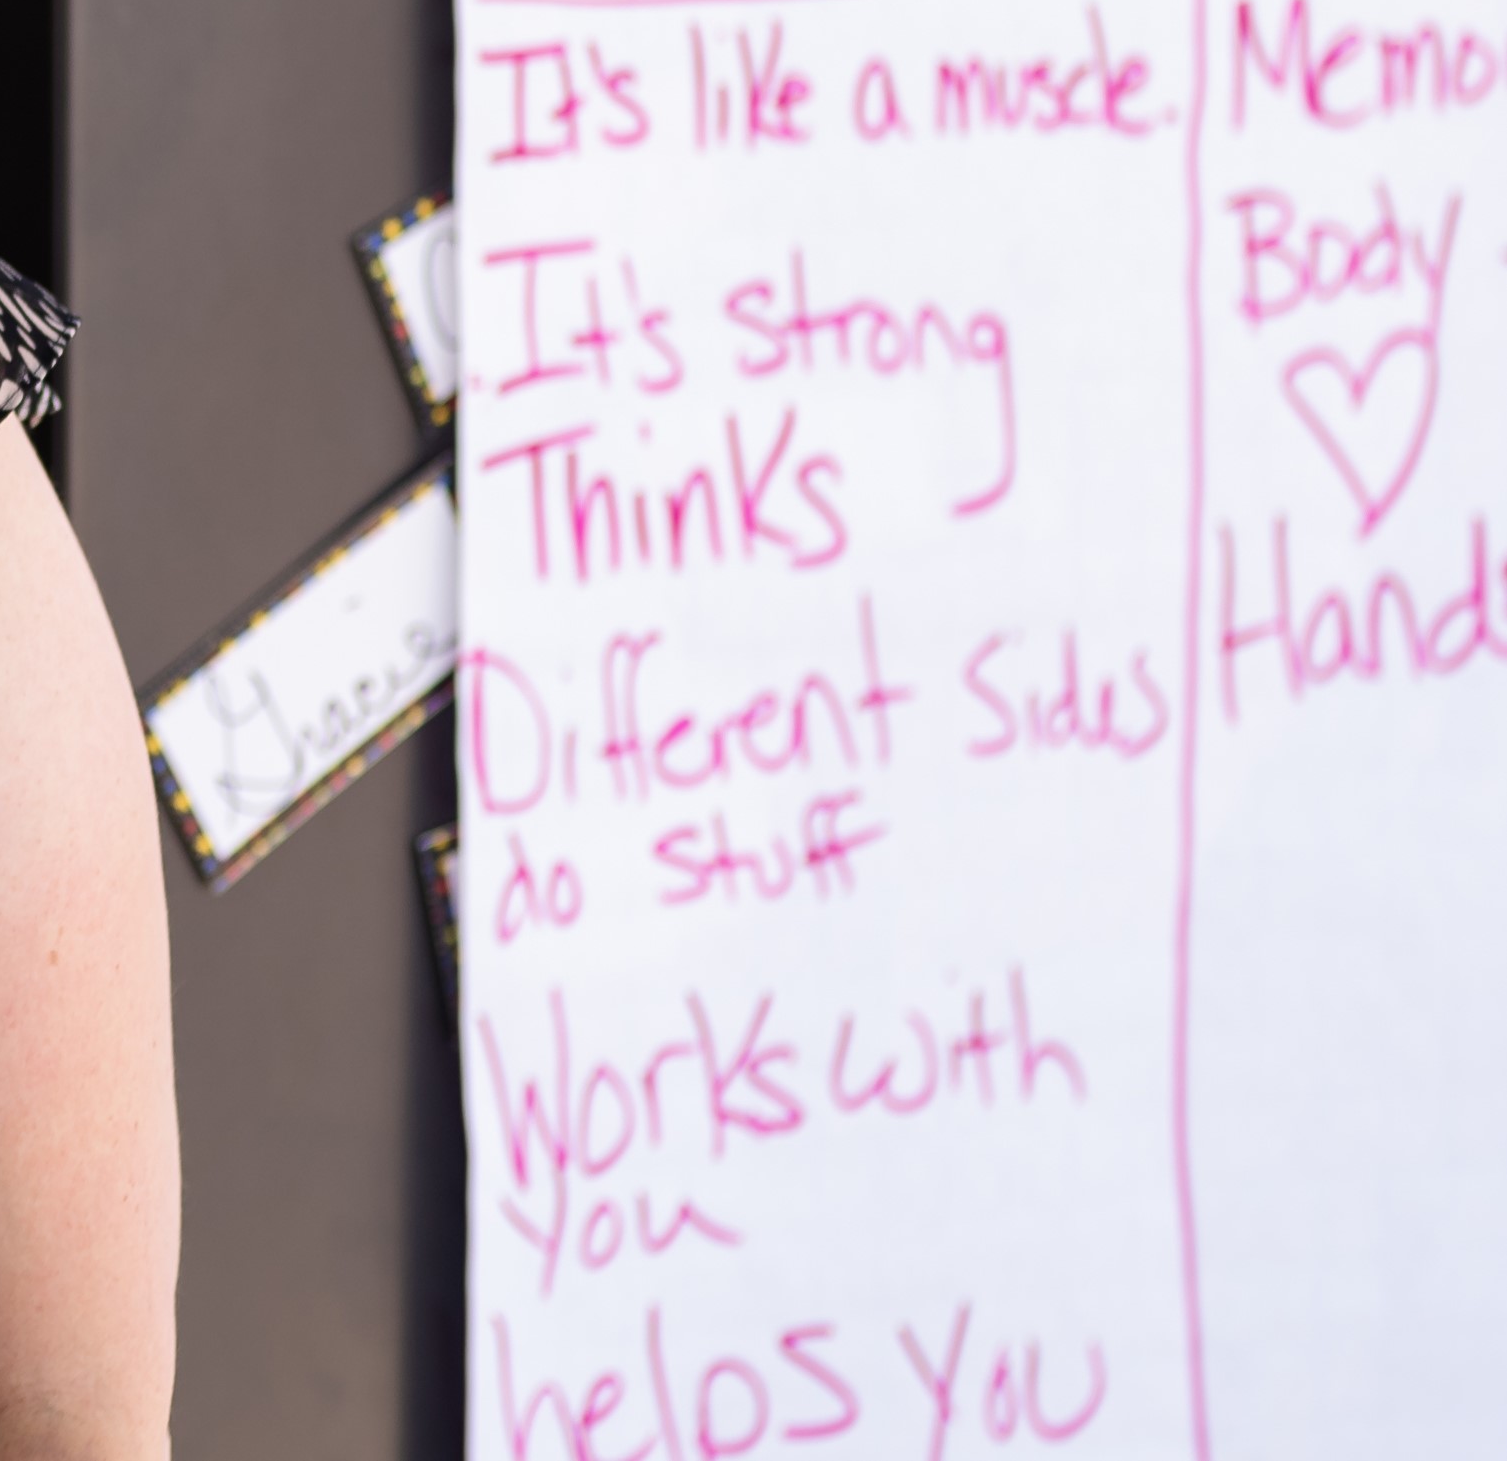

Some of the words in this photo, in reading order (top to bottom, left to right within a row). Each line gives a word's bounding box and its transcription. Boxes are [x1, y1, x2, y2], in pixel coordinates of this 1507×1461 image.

[474, 34, 654, 169] It's
[686, 14, 818, 152] like
[849, 52, 916, 146] a
[480, 236, 688, 400] It's
[1224, 180, 1464, 335] Body
[477, 404, 852, 586] Thinks
[1214, 512, 1507, 724] Hand
[458, 593, 916, 819] Different
[492, 830, 586, 946] do
[646, 788, 888, 908] stuff
[476, 987, 808, 1192] Works
